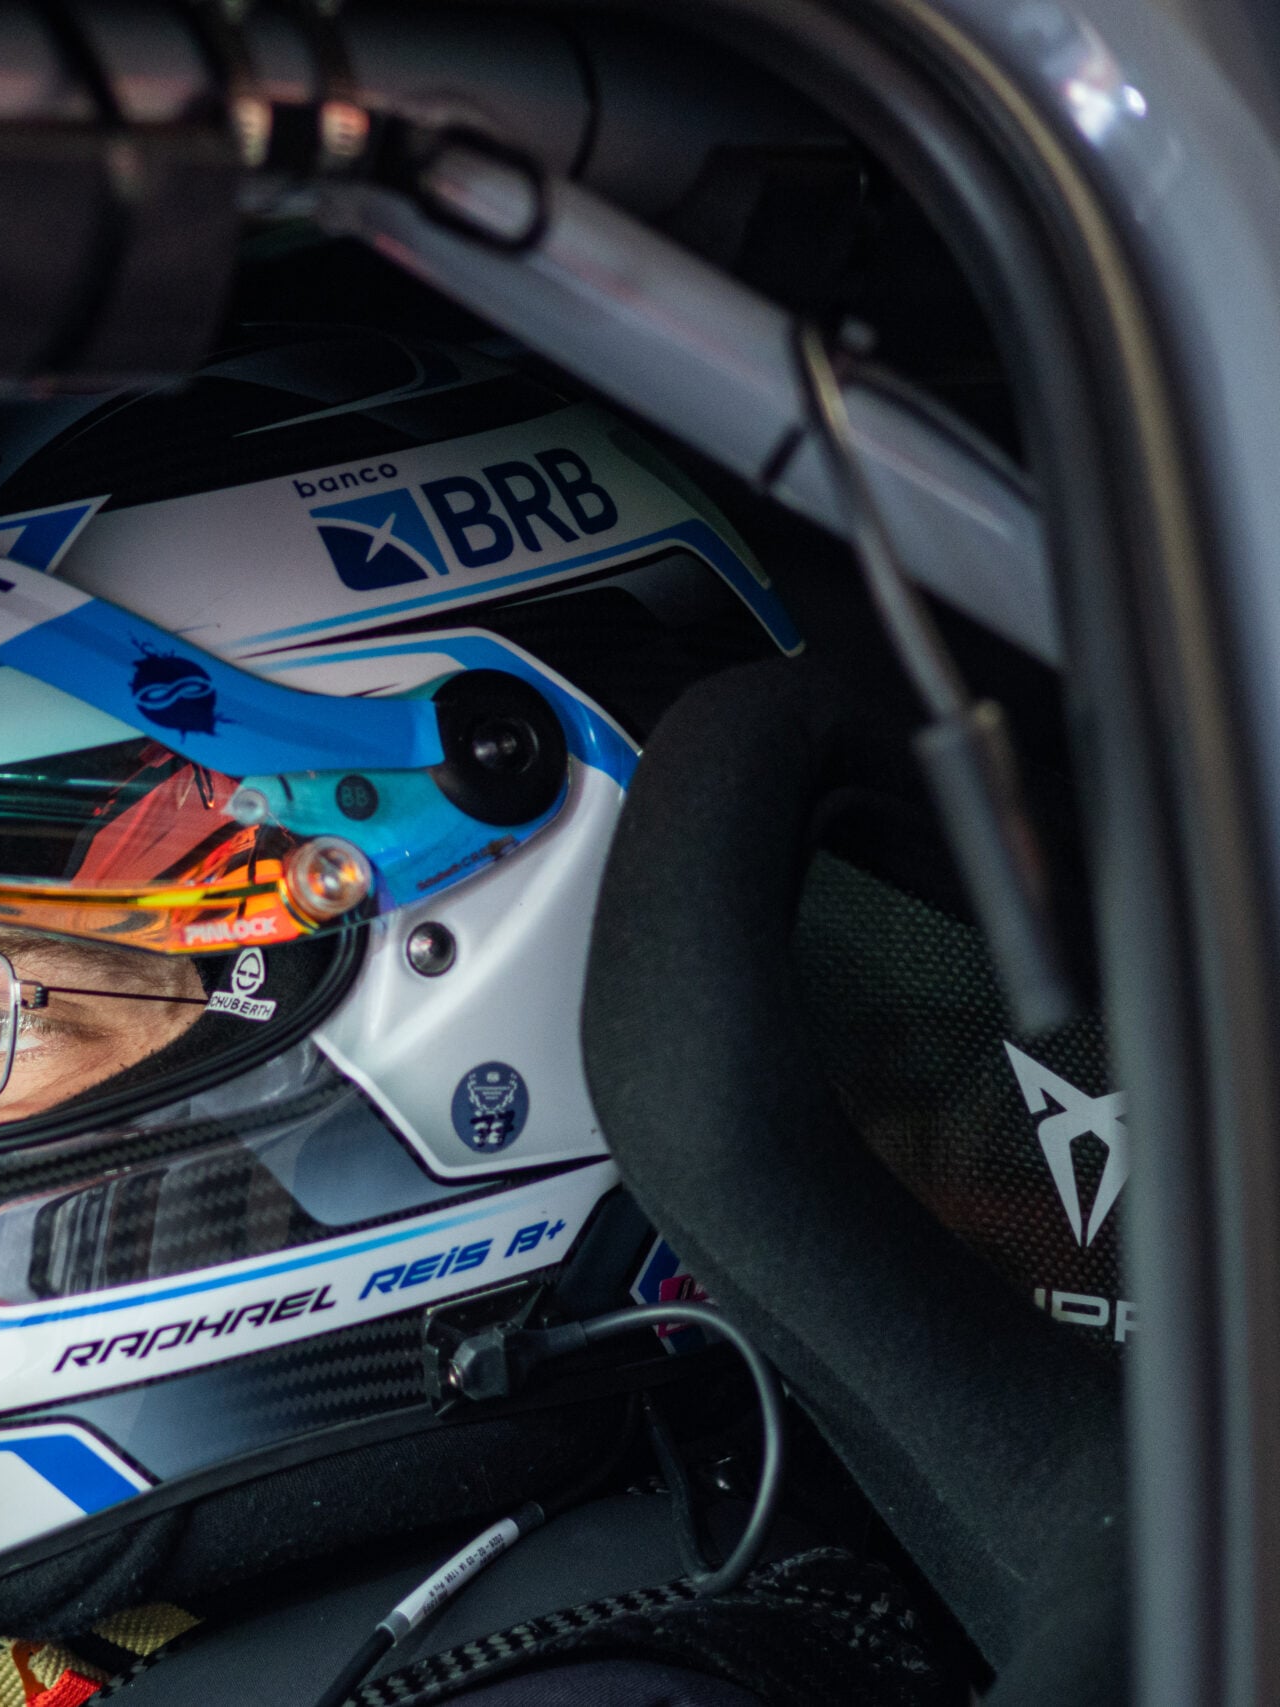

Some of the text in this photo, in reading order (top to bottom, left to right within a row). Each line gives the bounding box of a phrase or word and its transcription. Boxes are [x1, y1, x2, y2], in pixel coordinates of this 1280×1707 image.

[293, 459, 400, 500] banco
[420, 446, 619, 569] BRB
[183, 915, 278, 947] PINLOCK
[209, 995, 272, 1017] CHUBERTH
[52, 1284, 337, 1373] RAPHAEL
